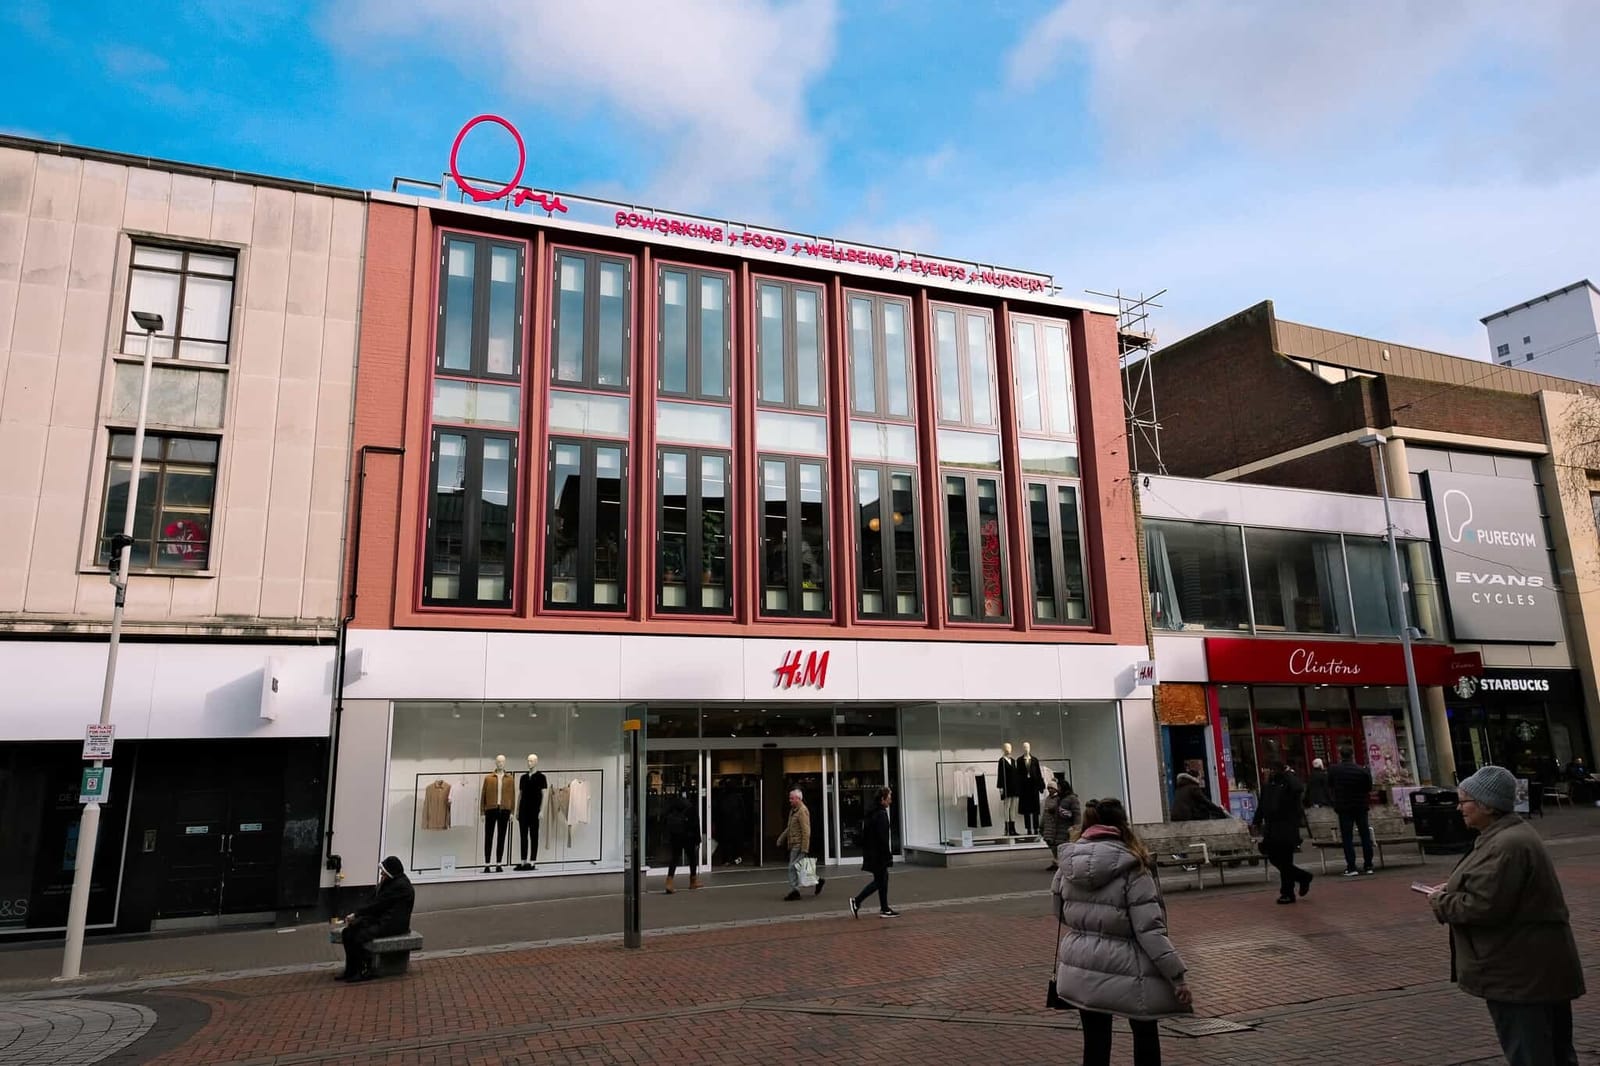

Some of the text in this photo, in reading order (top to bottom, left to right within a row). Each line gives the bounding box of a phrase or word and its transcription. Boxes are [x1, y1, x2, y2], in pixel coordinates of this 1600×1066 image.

[615, 211, 723, 242] COWORKING
[742, 231, 787, 251] FOOD
[804, 241, 894, 269] WELLBEING
[911, 259, 967, 280] EVENTS
[981, 271, 1047, 292] NURSERY
[1476, 529, 1536, 548] PUREGYM
[1455, 571, 1544, 587] EVANS
[1472, 592, 1535, 606] CYCLES
[776, 649, 830, 689] H&M
[1289, 648, 1361, 675] Clintons
[1480, 679, 1550, 691] STARBUCKS
